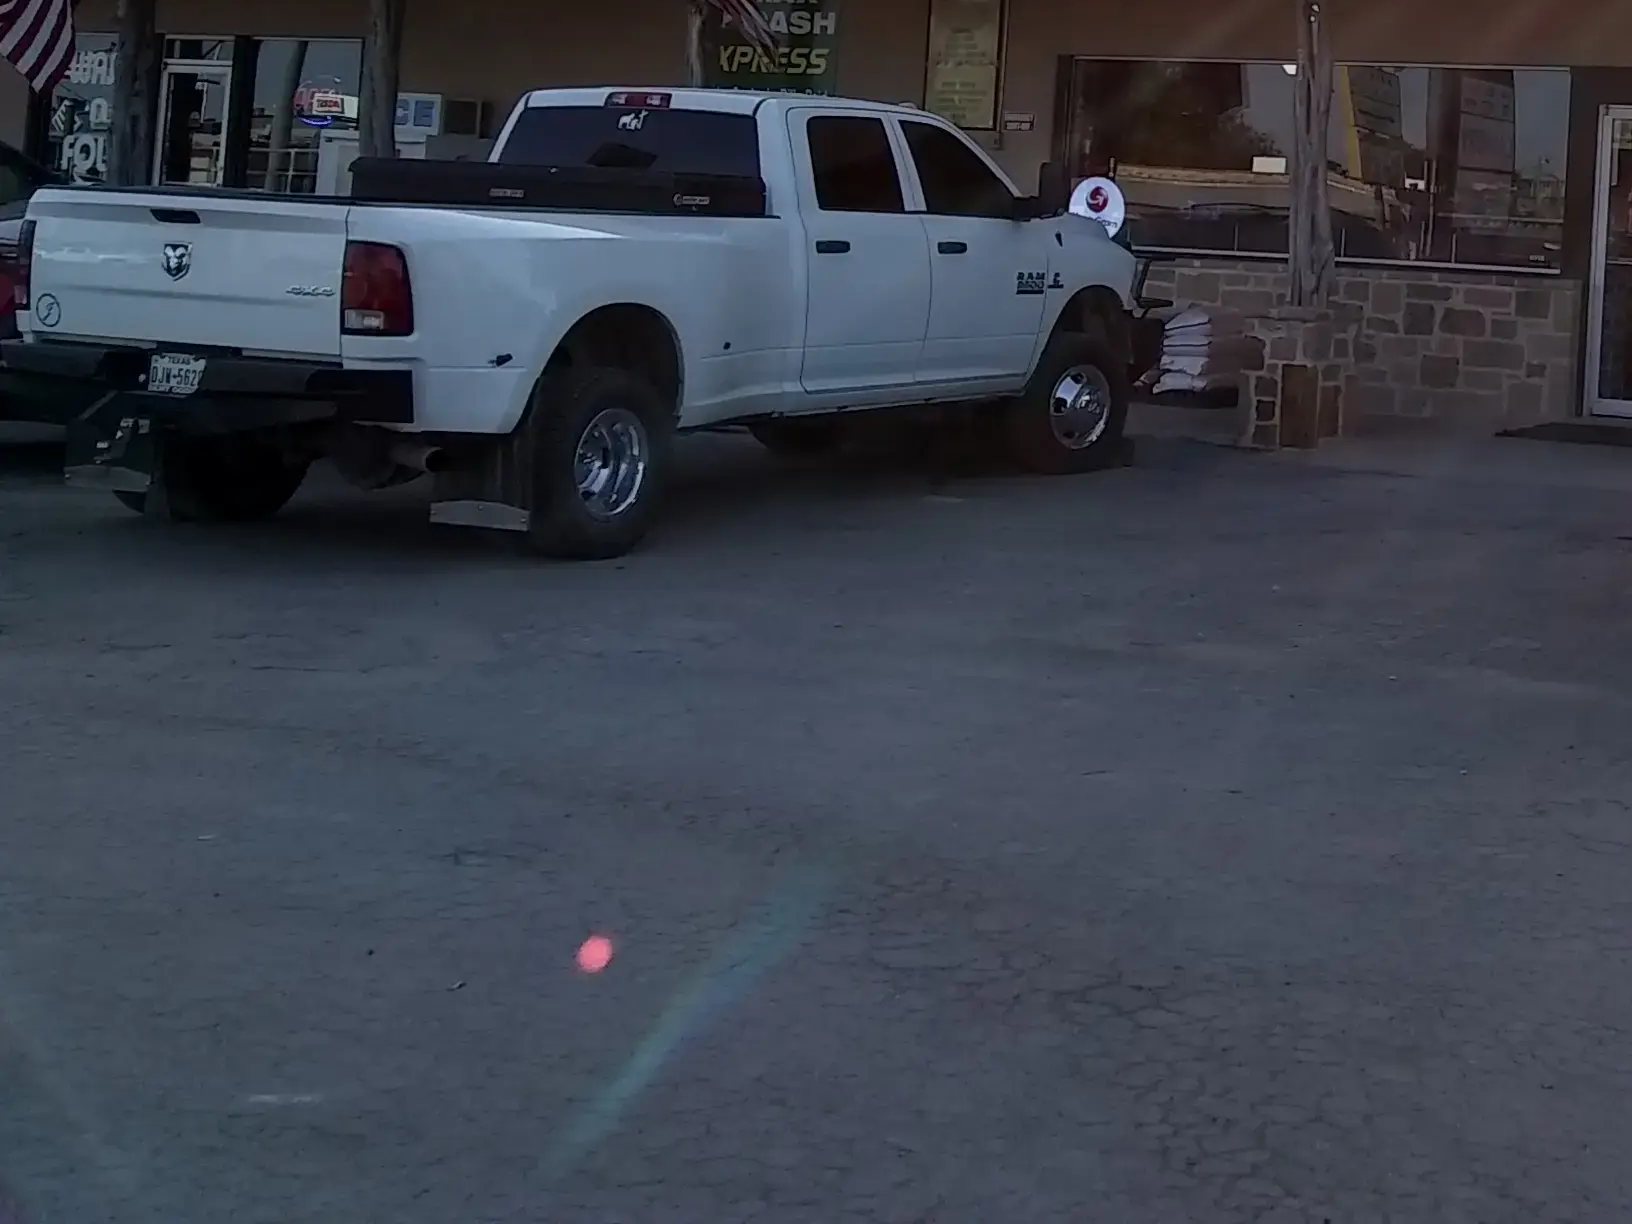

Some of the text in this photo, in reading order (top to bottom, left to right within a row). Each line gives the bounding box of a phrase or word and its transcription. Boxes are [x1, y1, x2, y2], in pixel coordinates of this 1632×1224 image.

[763, 10, 836, 35] ASH
[60, 135, 107, 173] FOL
[1016, 271, 1046, 281] RAM
